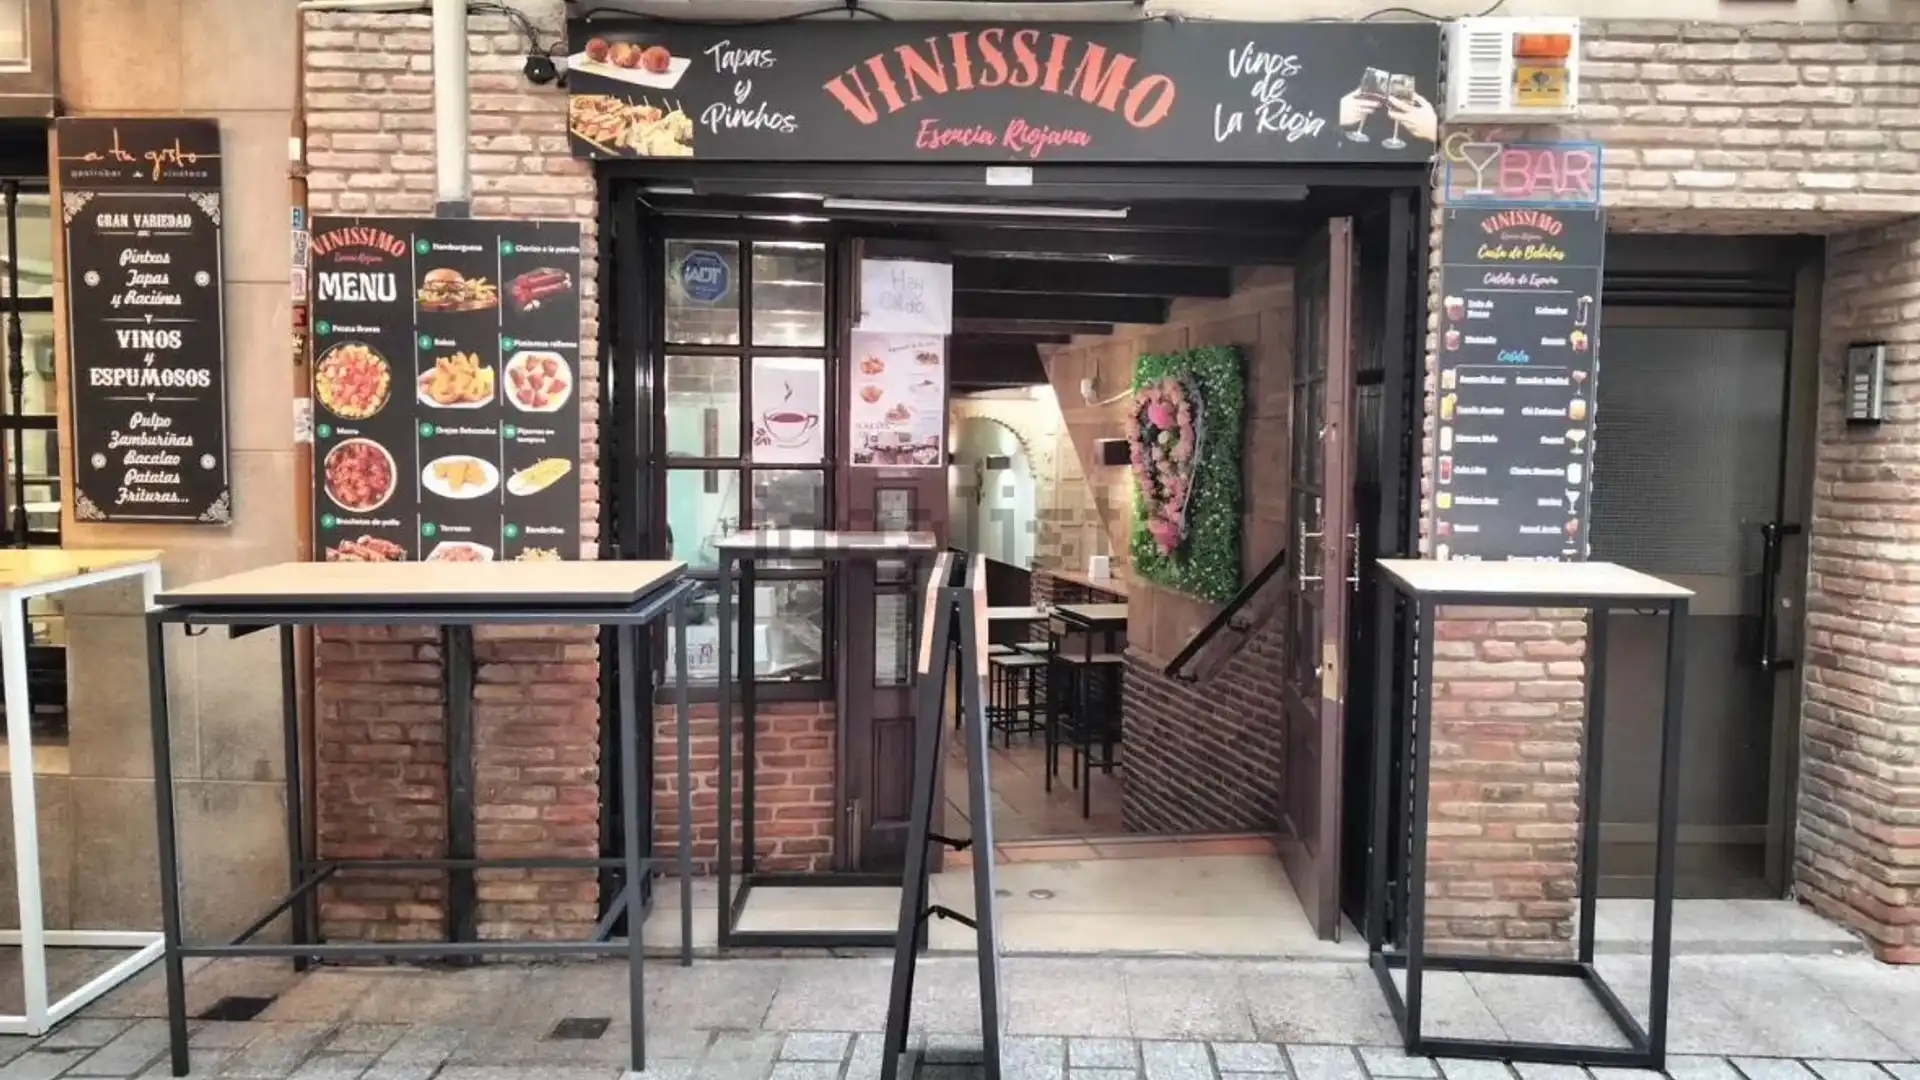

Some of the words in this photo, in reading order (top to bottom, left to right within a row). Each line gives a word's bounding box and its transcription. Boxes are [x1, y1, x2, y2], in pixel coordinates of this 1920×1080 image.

[703, 39, 777, 74] Tapas
[1228, 41, 1302, 78] Vinos
[733, 78, 752, 104] y
[822, 28, 1176, 128] VINISSIMO
[1250, 72, 1288, 103] de
[700, 101, 798, 134] Pinchos
[1213, 102, 1243, 143] La
[1255, 97, 1326, 143] Rioja
[84, 151, 104, 163] a
[108, 127, 136, 162] tu
[915, 118, 997, 149] Esencia
[1001, 118, 1092, 158] Riojana
[1500, 148, 1592, 196] BAR
[96, 213, 129, 228] GRAN
[133, 213, 192, 228] VARIEDAD
[1481, 209, 1564, 236] VINISSIMO
[311, 226, 407, 257] VINISSIMO
[119, 248, 171, 266] Pintxos
[125, 269, 170, 288] Tapas
[318, 271, 397, 302] MENU
[684, 266, 722, 285] ADT
[110, 293, 122, 308] y
[115, 329, 182, 349] VINOS
[143, 352, 155, 367] y
[89, 367, 211, 387] ESPUMOSOS
[129, 410, 173, 431] Pulpo
[107, 430, 194, 449] Zamburiñas
[123, 449, 181, 466] Bacalao
[123, 468, 181, 486] Patatas
